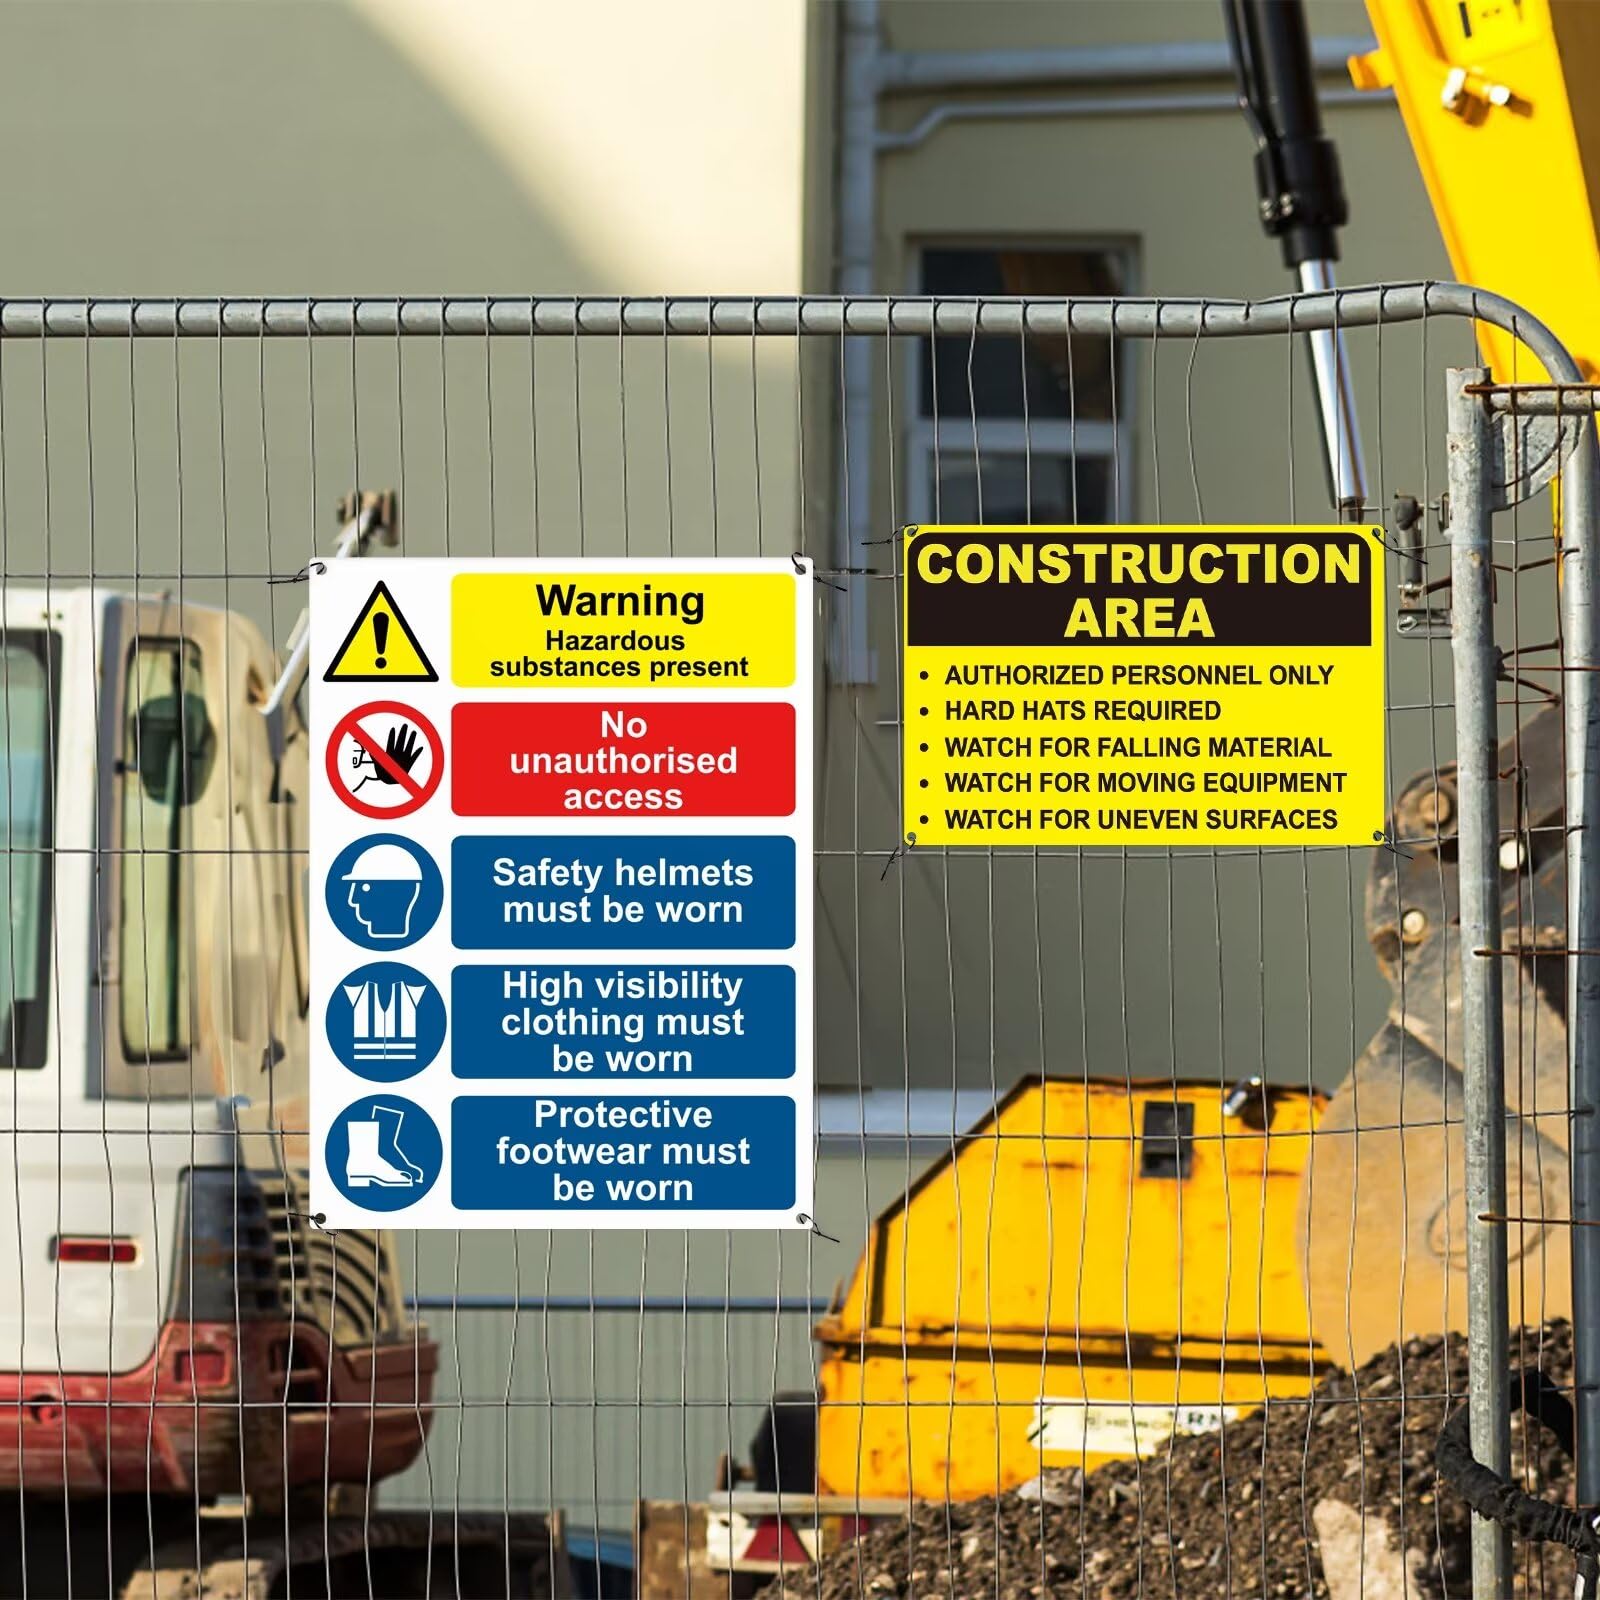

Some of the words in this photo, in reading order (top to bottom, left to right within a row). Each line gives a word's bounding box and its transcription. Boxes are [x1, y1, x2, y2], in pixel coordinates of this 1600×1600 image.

[917, 543, 1360, 584] CONSTRUCTION
[536, 585, 703, 624] Warning
[1064, 598, 1215, 637] AREA
[547, 630, 684, 650] Hazardous
[491, 656, 640, 676] substances
[651, 657, 748, 681] present
[945, 665, 1103, 685] AUTHORIZED
[1113, 665, 1261, 685] PERSONNEL
[1270, 665, 1334, 685] ONLY
[947, 701, 1014, 720] HARD
[1024, 700, 1085, 720] HATS
[1095, 700, 1221, 721] REQUIRED
[602, 711, 647, 738] No
[511, 747, 736, 773] unauthorised
[945, 737, 1031, 757] WATCH
[1040, 737, 1089, 757] FOR
[1099, 737, 1200, 757] FALLING
[1209, 738, 1332, 757] MATERIAL
[945, 773, 1031, 792] WATCH
[1040, 772, 1090, 792] FOR
[1099, 772, 1194, 792] MOVING
[1204, 773, 1347, 793] EQUIPMENT
[564, 789, 682, 809] access
[945, 809, 1031, 829] WATCH
[1041, 809, 1090, 829] FOR
[1099, 810, 1197, 829] UNEVEN
[1206, 809, 1337, 829] SURFACES
[494, 858, 603, 893] Safety
[616, 858, 753, 886] helmets
[505, 896, 591, 922] must
[604, 895, 643, 922] be
[656, 902, 742, 922] worn
[504, 971, 582, 1006] High
[595, 971, 742, 1006] visibility
[502, 1008, 643, 1042] clothing
[658, 1009, 744, 1035] must
[554, 1044, 593, 1071] be
[606, 1051, 691, 1071] worn
[536, 1100, 712, 1127] Protective
[497, 1136, 651, 1164] footwear
[664, 1138, 750, 1164] must
[554, 1174, 594, 1201] be
[606, 1180, 692, 1201] worn
